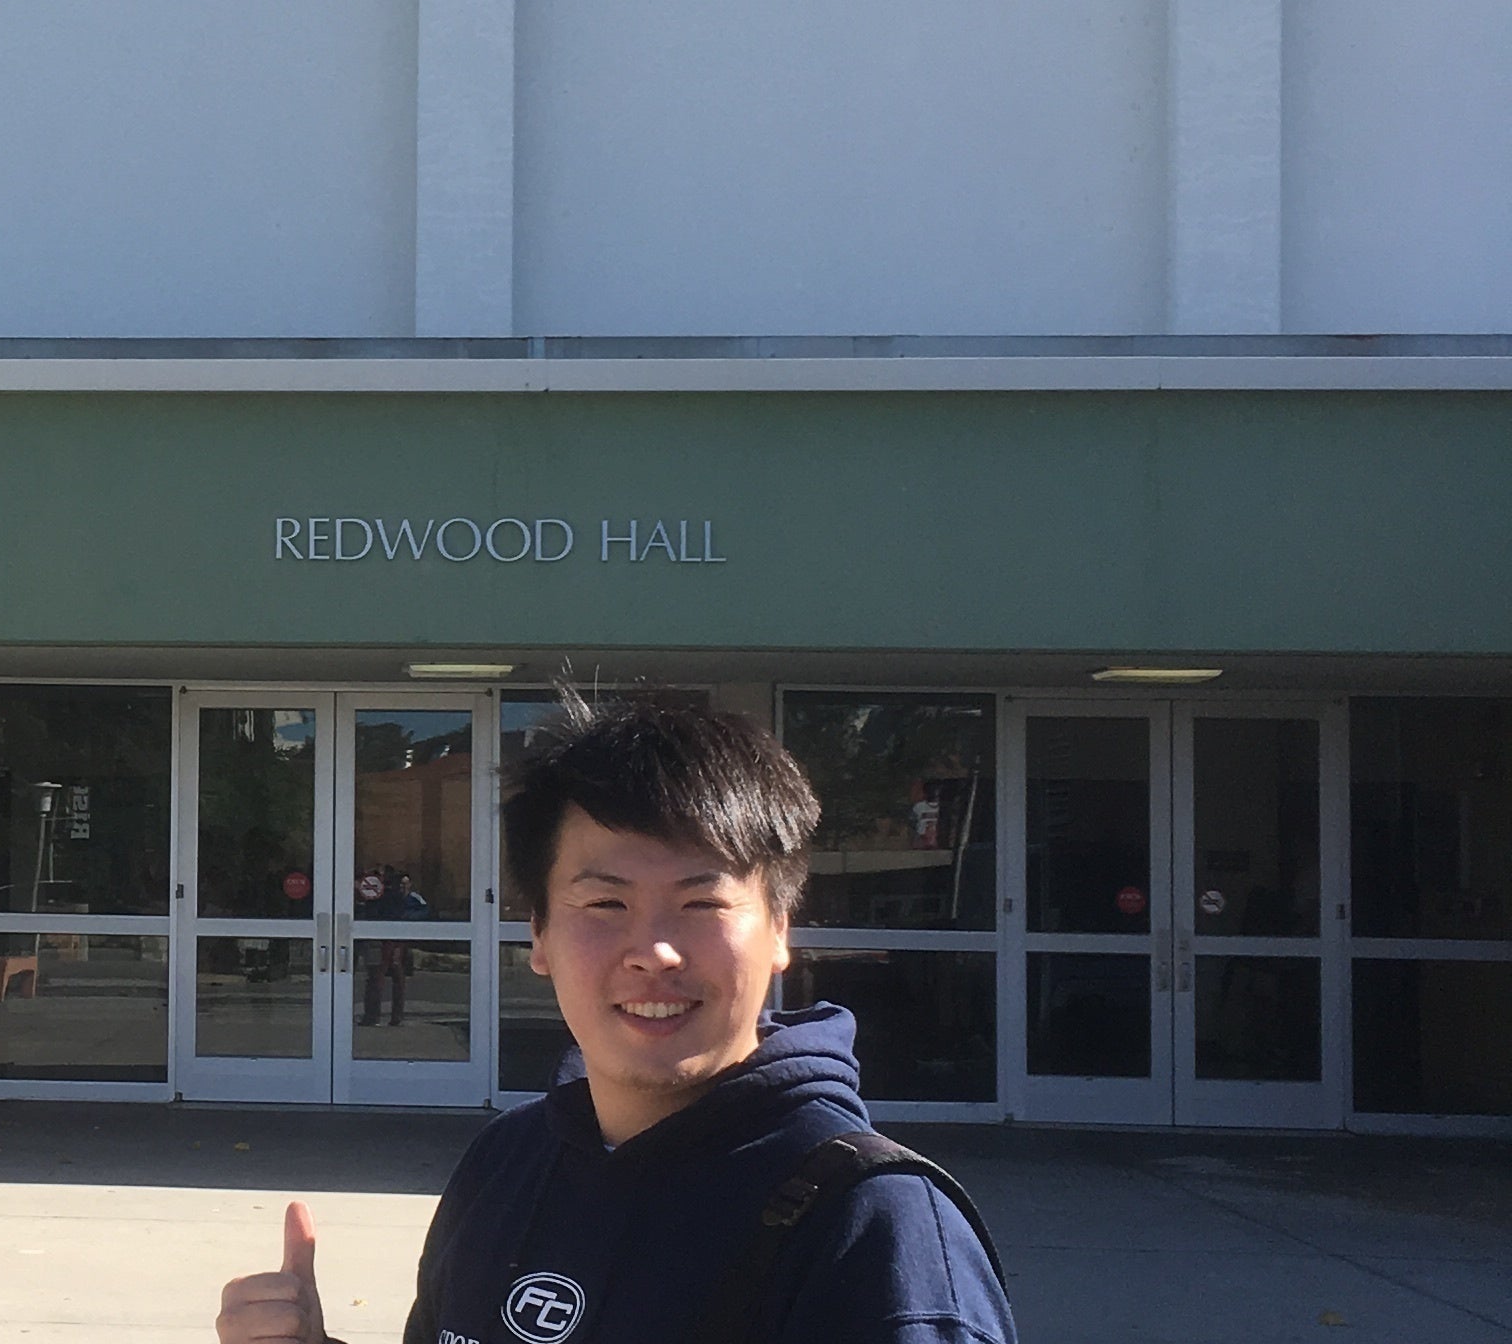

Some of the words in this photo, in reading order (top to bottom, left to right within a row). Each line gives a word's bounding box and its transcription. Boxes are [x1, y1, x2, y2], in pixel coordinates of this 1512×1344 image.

[275, 517, 574, 562] REDWOOD
[601, 519, 727, 563] HALL
[514, 1286, 574, 1331] FC
